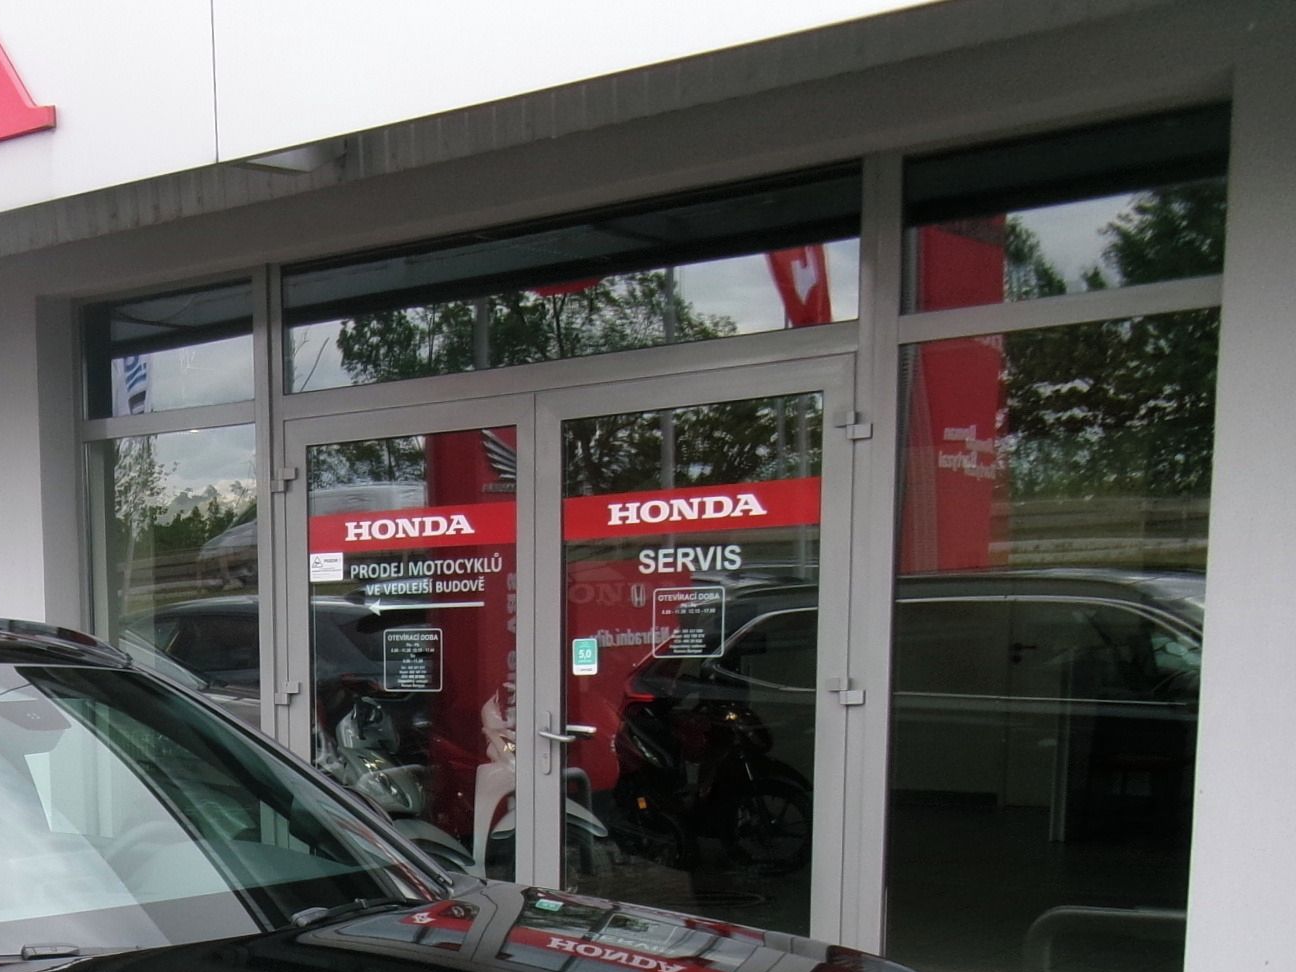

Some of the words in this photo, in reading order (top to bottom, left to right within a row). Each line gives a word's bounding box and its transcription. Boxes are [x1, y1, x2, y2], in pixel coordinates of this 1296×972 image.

[607, 493, 768, 526] HONDA
[345, 514, 475, 541] HONDA
[350, 562, 404, 579] PRODEJ
[408, 552, 502, 577] MOTOCYKLŮ
[638, 544, 742, 574] SERVIS
[366, 585, 381, 596] VE
[383, 577, 433, 595] VEDLEJŠÍ
[435, 576, 485, 593] BUDOVĚ
[698, 592, 720, 600] DOBA
